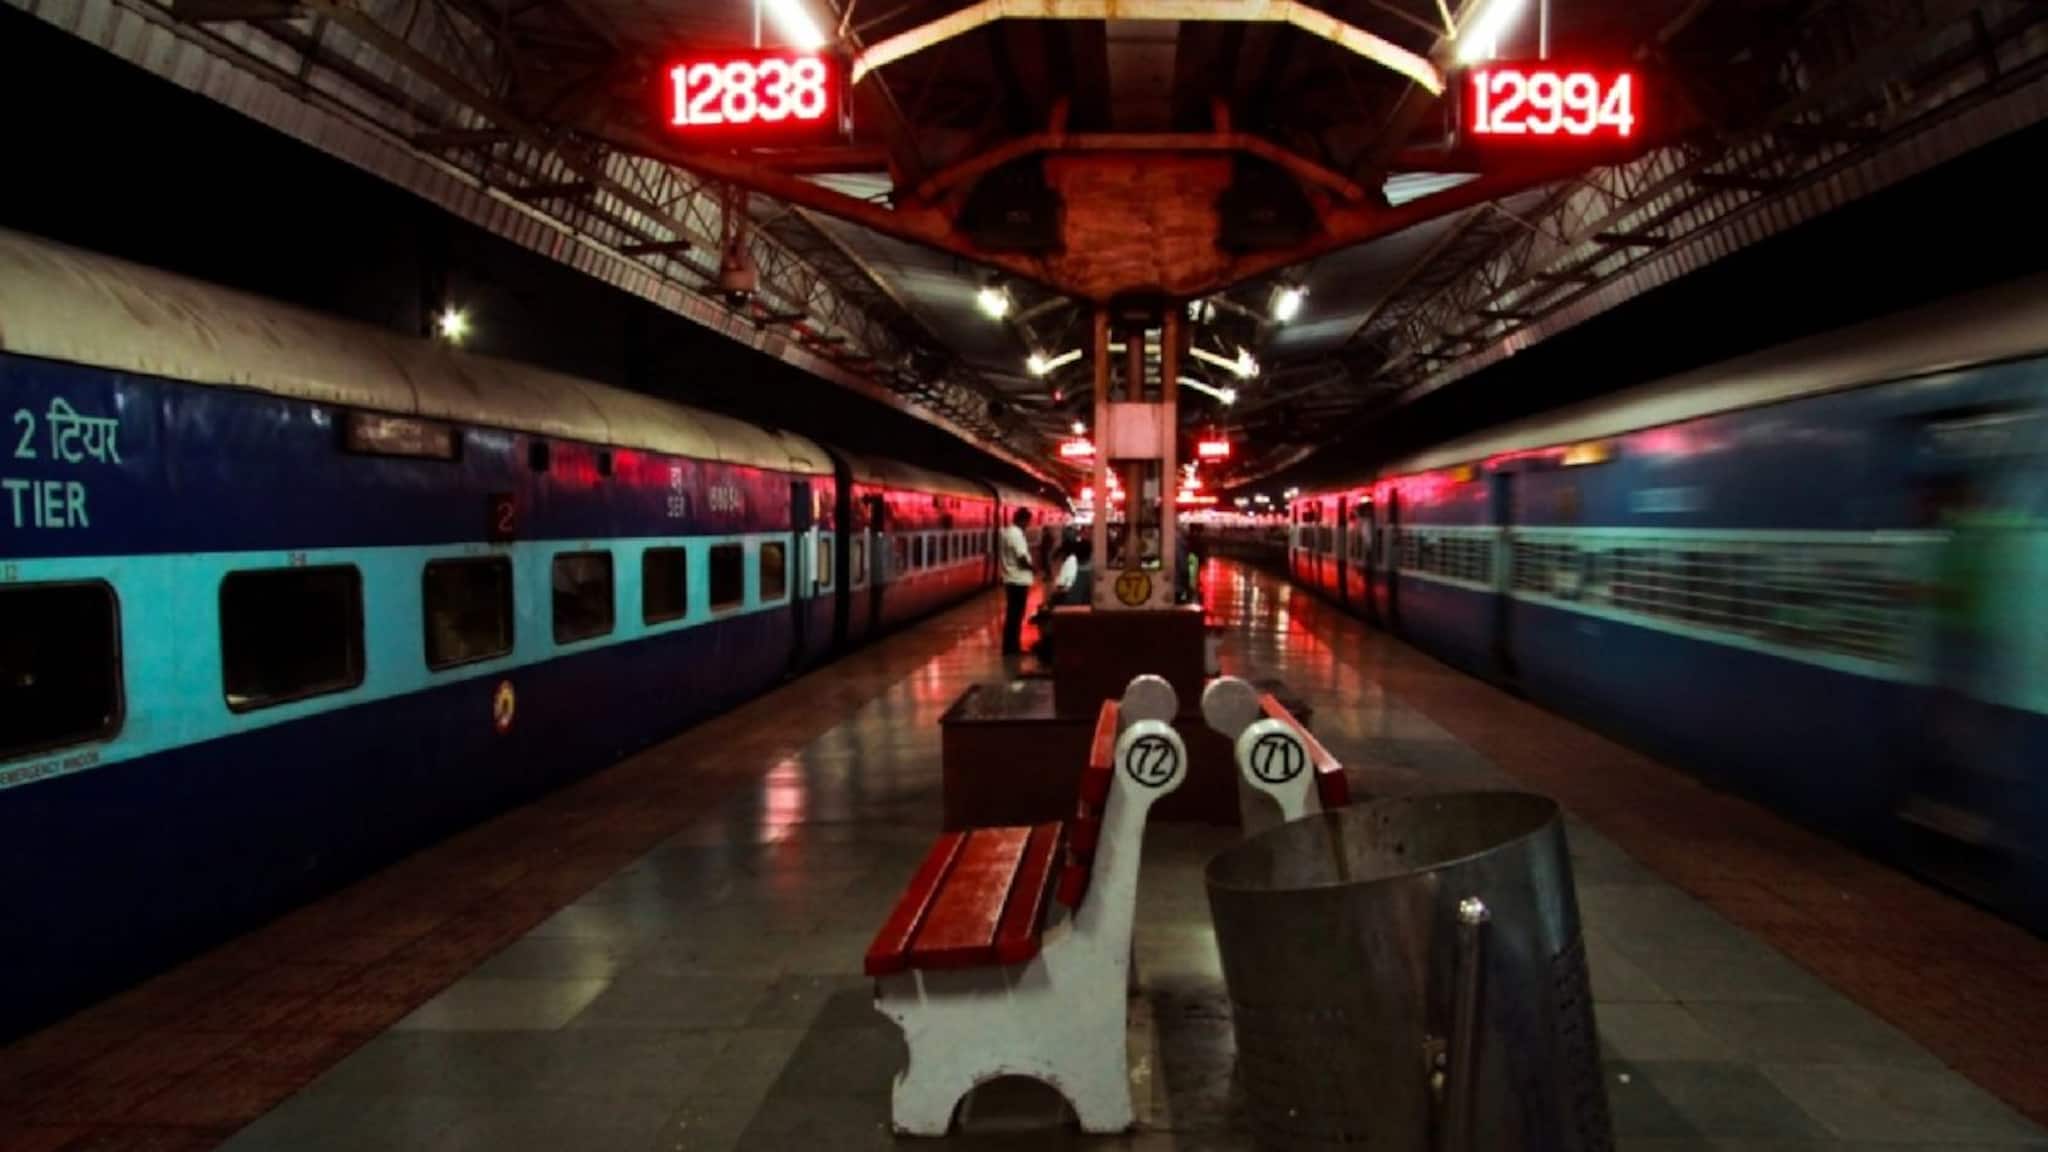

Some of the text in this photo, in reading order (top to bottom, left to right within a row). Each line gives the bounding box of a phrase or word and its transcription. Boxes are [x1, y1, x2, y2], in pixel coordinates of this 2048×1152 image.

[670, 57, 827, 126] 12838
[1472, 70, 1634, 136] 12994
[13, 396, 122, 464] 2 टियर
[1, 478, 89, 528] TIER
[497, 502, 514, 532] 2
[1136, 742, 1169, 776] 72
[1261, 741, 1291, 775] 71
